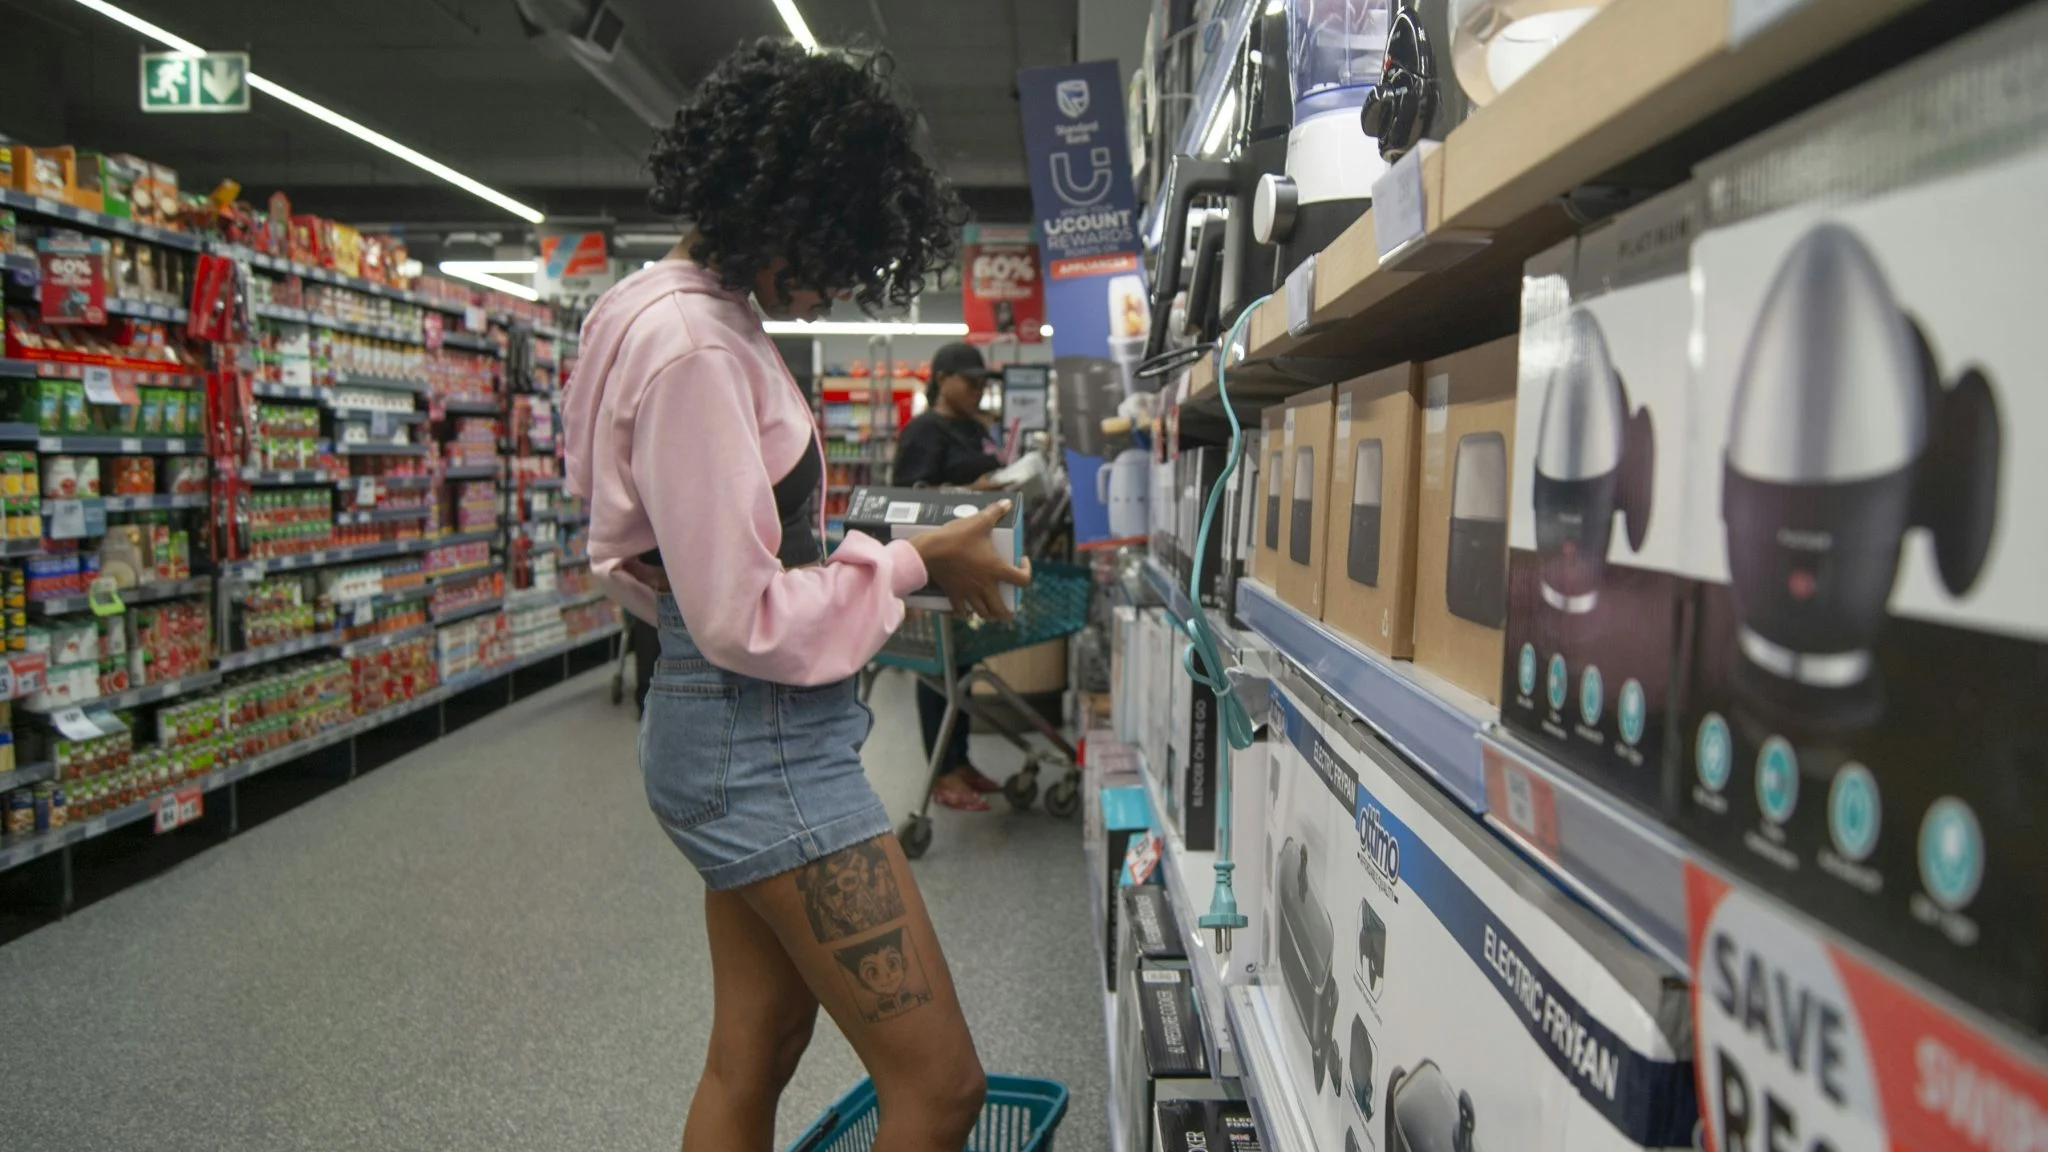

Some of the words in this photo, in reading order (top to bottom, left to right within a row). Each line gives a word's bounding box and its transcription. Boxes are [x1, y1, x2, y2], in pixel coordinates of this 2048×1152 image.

[1066, 133, 1091, 145] Bank
[1044, 209, 1131, 235] UCOUNT
[1047, 228, 1134, 251] REWARDS
[49, 259, 93, 276] 60%
[973, 255, 1036, 281] 60%
[1194, 699, 1206, 720] GO
[1194, 722, 1206, 741] THE
[1193, 742, 1205, 761] ON
[1192, 762, 1205, 808] BLENDER
[1313, 739, 1334, 781] ELECTRIC
[1334, 763, 1356, 807] FRYPAN
[1359, 803, 1400, 885] ottimo
[1484, 924, 1543, 1022] ELECTRIC
[1156, 989, 1178, 1016] COOKER
[1160, 1016, 1183, 1046] PRESSURE
[1711, 931, 1848, 1110] SAVE
